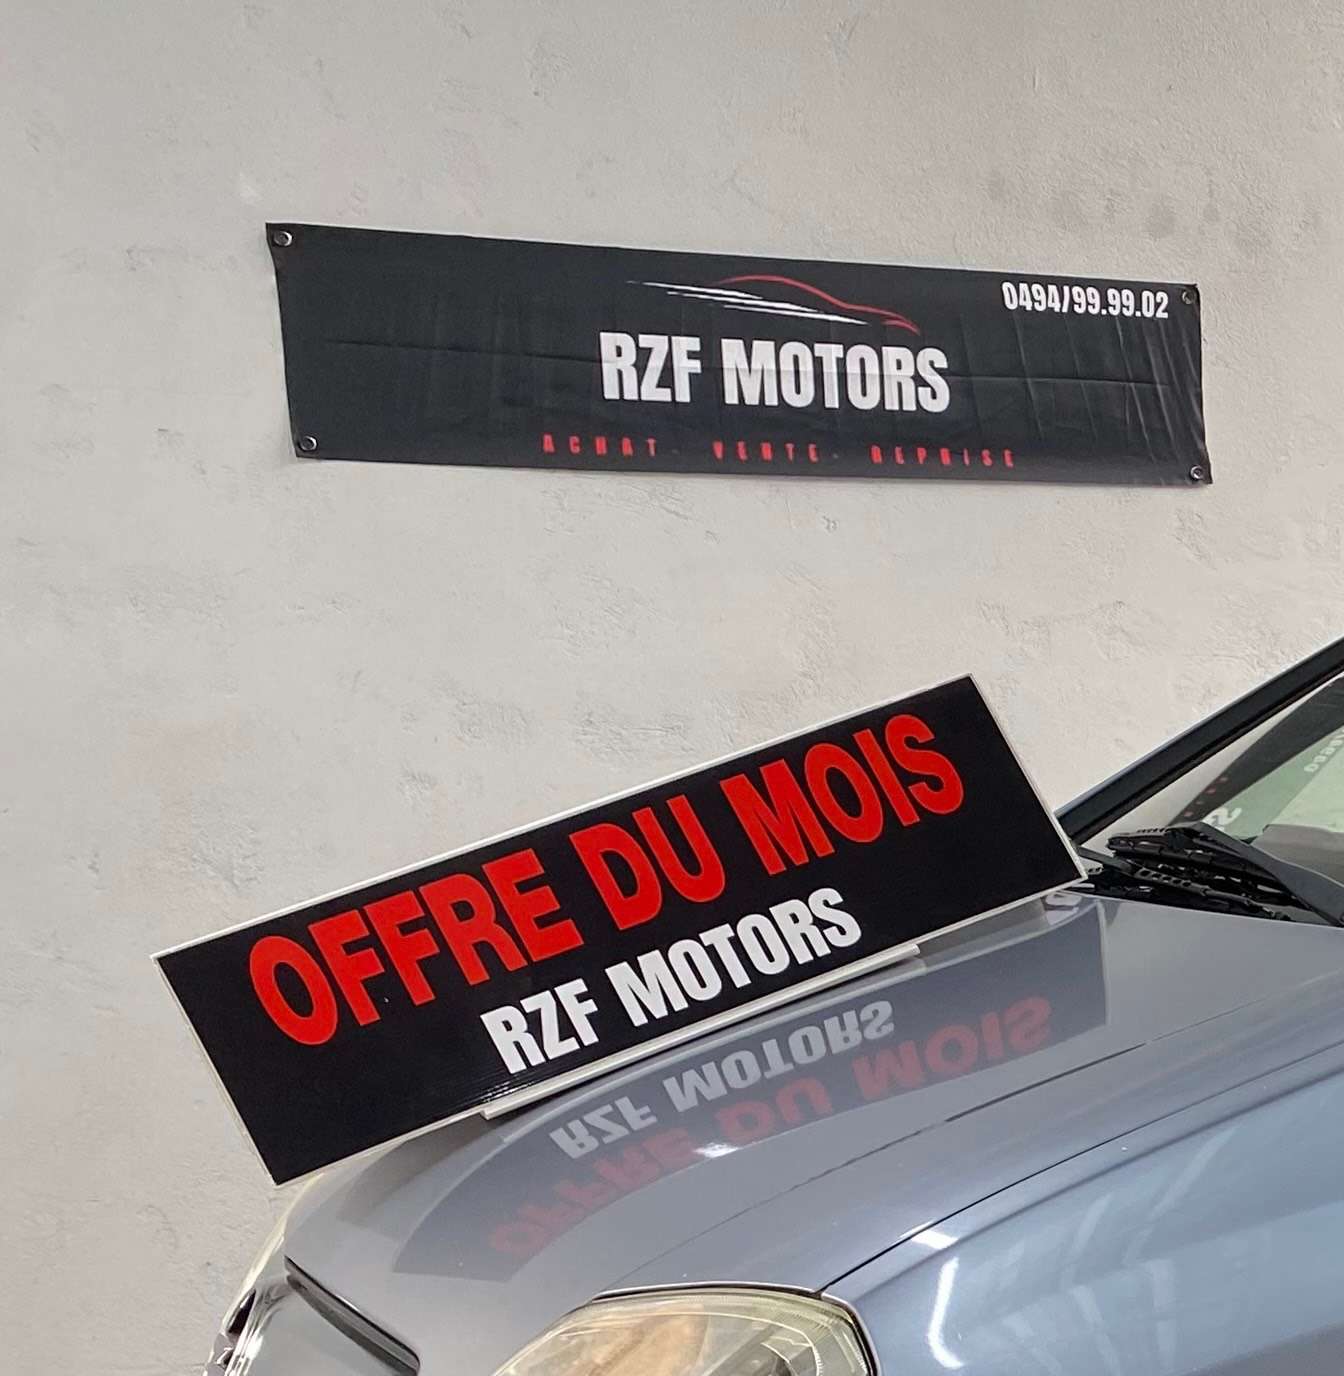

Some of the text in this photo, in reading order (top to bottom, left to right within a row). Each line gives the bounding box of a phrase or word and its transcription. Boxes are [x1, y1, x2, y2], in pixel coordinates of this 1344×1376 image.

[1002, 282, 1168, 318] 0494/99.99.02
[600, 331, 950, 412] RZF MOTORS
[543, 434, 1013, 468] ACHAT VENTE REPRISE
[248, 713, 965, 1047] OFFRE DU MOIS
[480, 888, 863, 1075] RZF MOTORS
